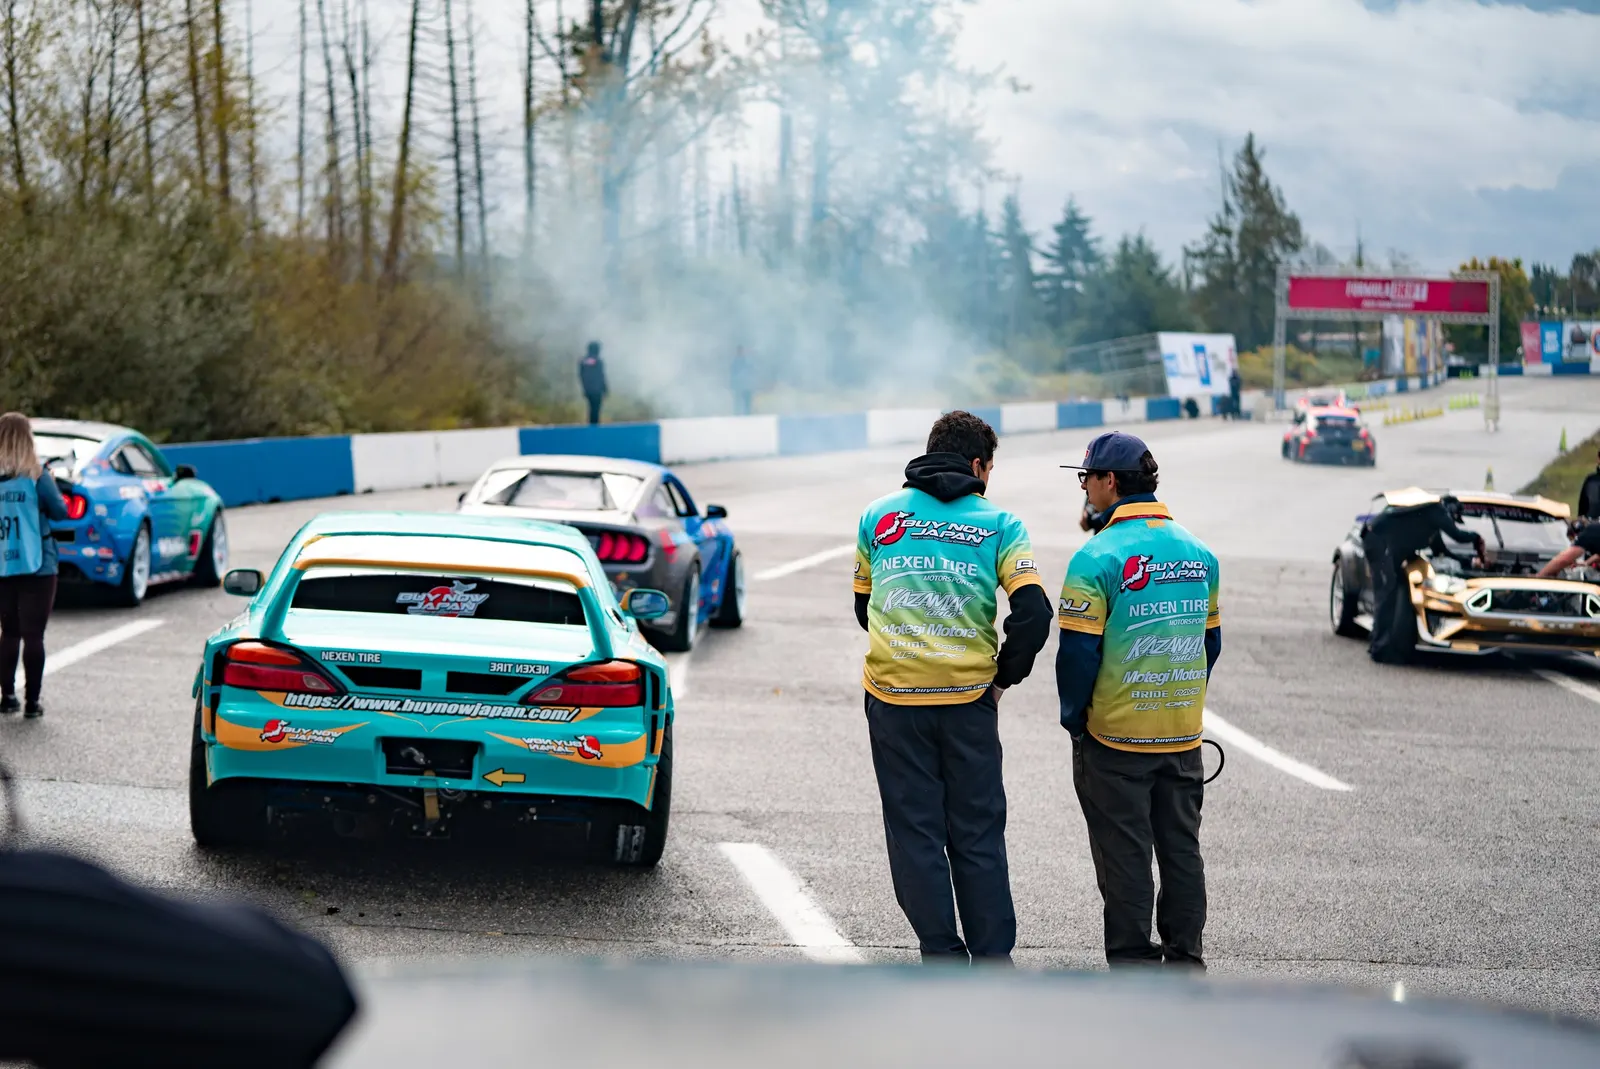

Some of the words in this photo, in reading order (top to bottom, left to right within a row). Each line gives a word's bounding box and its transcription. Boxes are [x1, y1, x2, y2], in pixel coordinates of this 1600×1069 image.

[901, 519, 947, 528] BUY
[948, 523, 998, 538] NOW
[911, 528, 984, 544] JAPAN
[882, 555, 935, 571] NEXEN
[940, 557, 978, 577] TIRE
[1145, 560, 1181, 573] BUY
[1154, 569, 1207, 580] JAPAN
[1129, 601, 1177, 617] NEXEN
[1181, 599, 1209, 612] TIRE
[881, 622, 926, 637] Motegi
[926, 623, 977, 638] Motors
[321, 651, 355, 662] NEXEN
[357, 653, 381, 663] TIRE
[1122, 670, 1171, 686] Motegi
[1171, 668, 1207, 682] Motors
[1131, 690, 1169, 699] BRIDE
[284, 692, 580, 721] https://www.buynowjapan.com/
[282, 726, 312, 734] BUY
[312, 730, 343, 738] NOW
[288, 734, 336, 744] JAPAN
